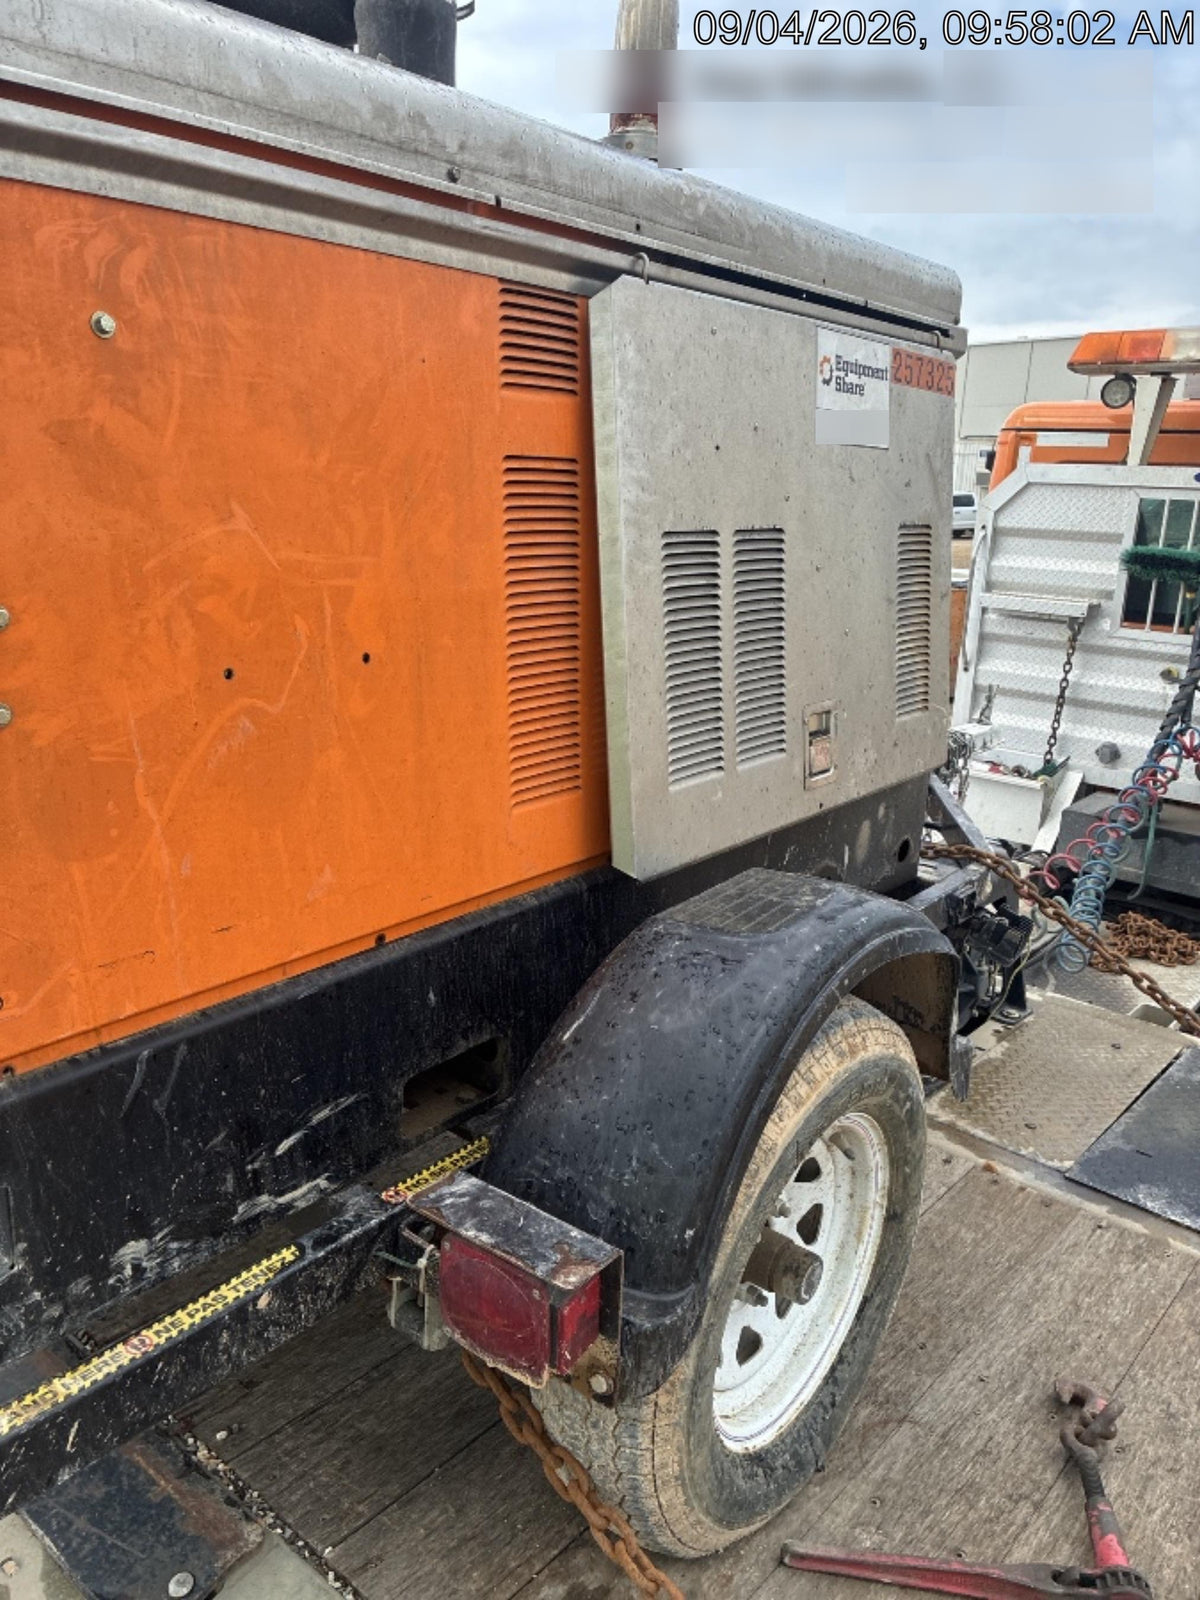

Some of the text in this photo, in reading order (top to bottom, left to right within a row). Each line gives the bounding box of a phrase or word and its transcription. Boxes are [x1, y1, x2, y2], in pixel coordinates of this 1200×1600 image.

[835, 354, 888, 381] Equipment
[893, 351, 956, 397] 257325
[834, 376, 865, 396] Share
[153, 1317, 185, 1336] NE
[186, 1294, 228, 1317] PAS
